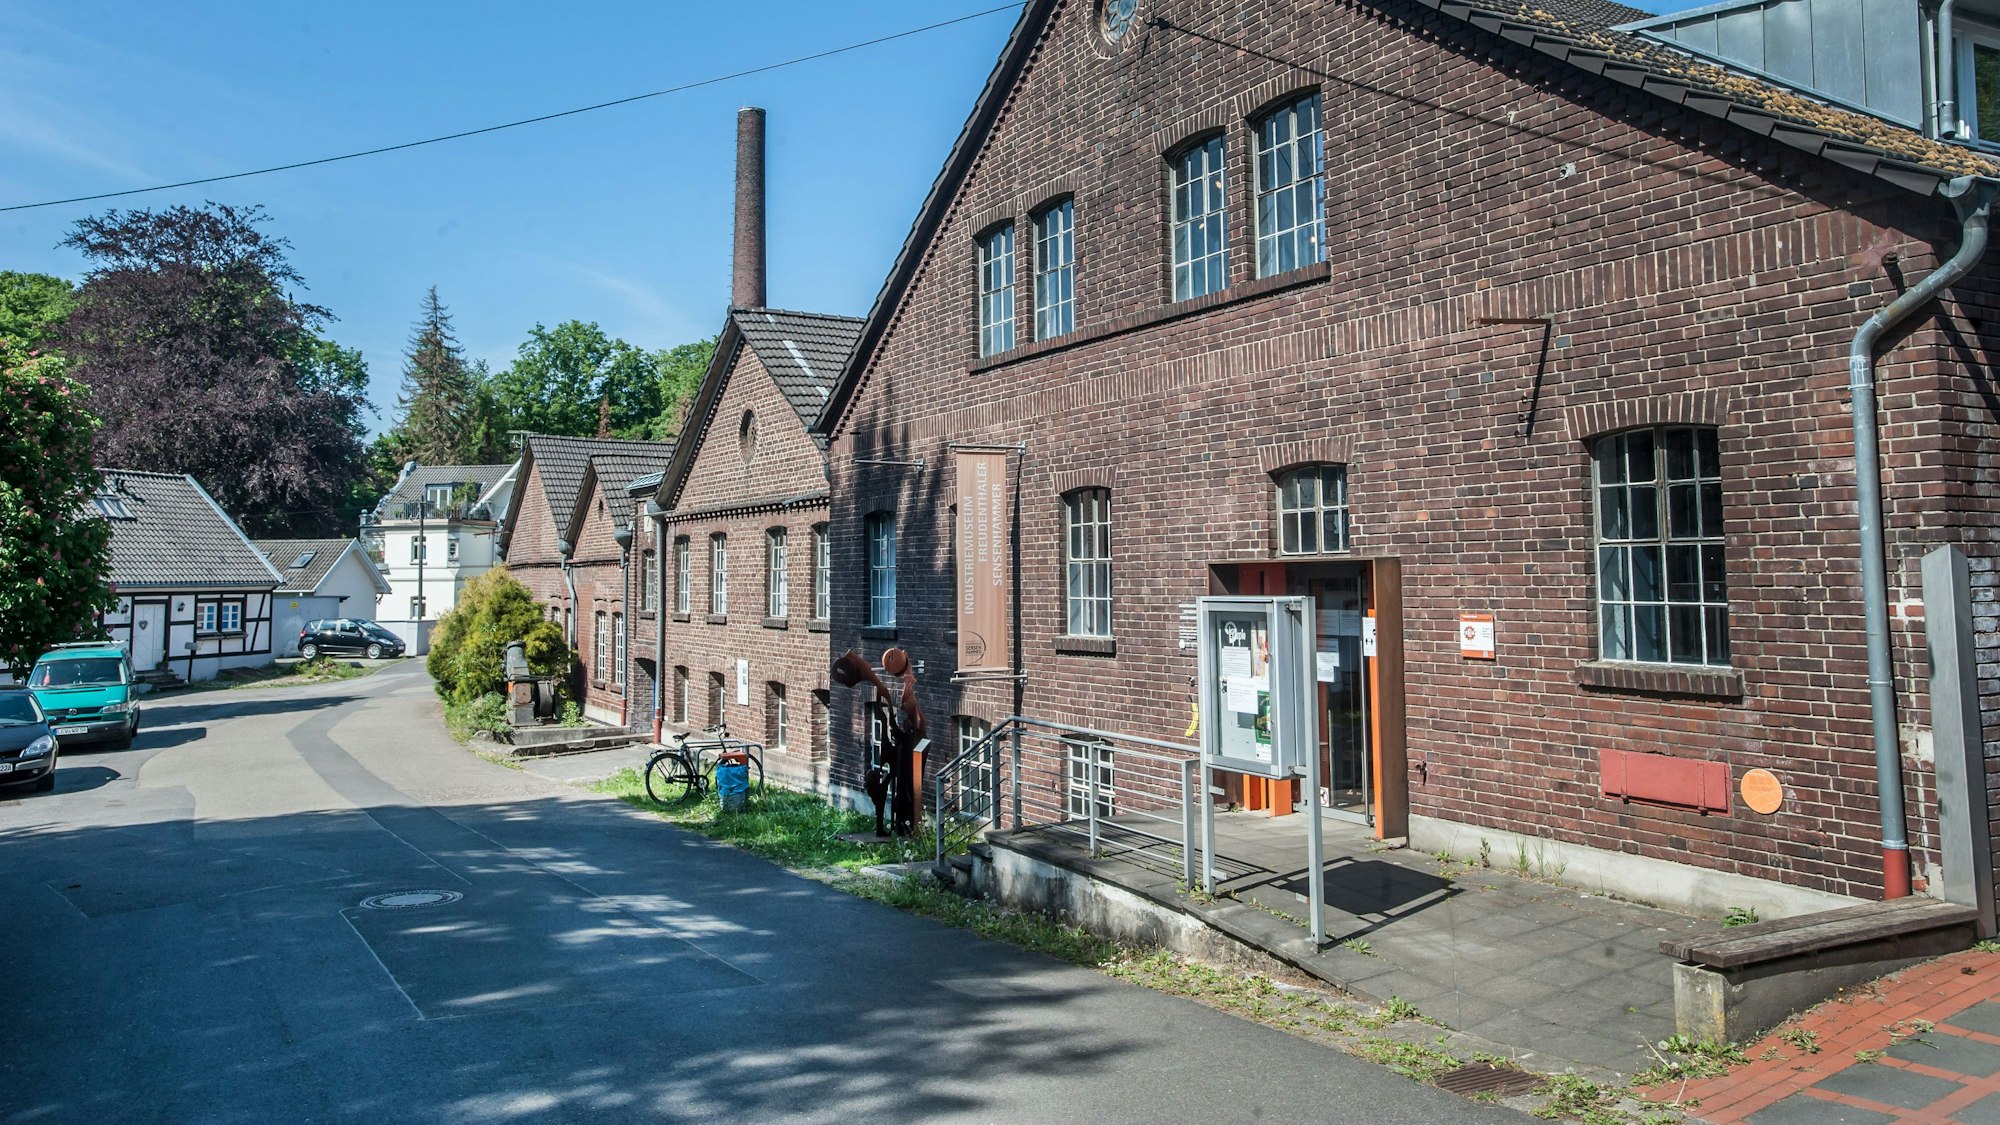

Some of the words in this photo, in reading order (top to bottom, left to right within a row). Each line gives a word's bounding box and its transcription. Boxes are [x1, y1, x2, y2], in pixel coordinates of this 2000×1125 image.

[964, 496, 974, 615] INDUSTRIEMUSEUM
[977, 462, 988, 561] FREUDENTHALER
[992, 483, 1003, 586] SENSENHAMMER
